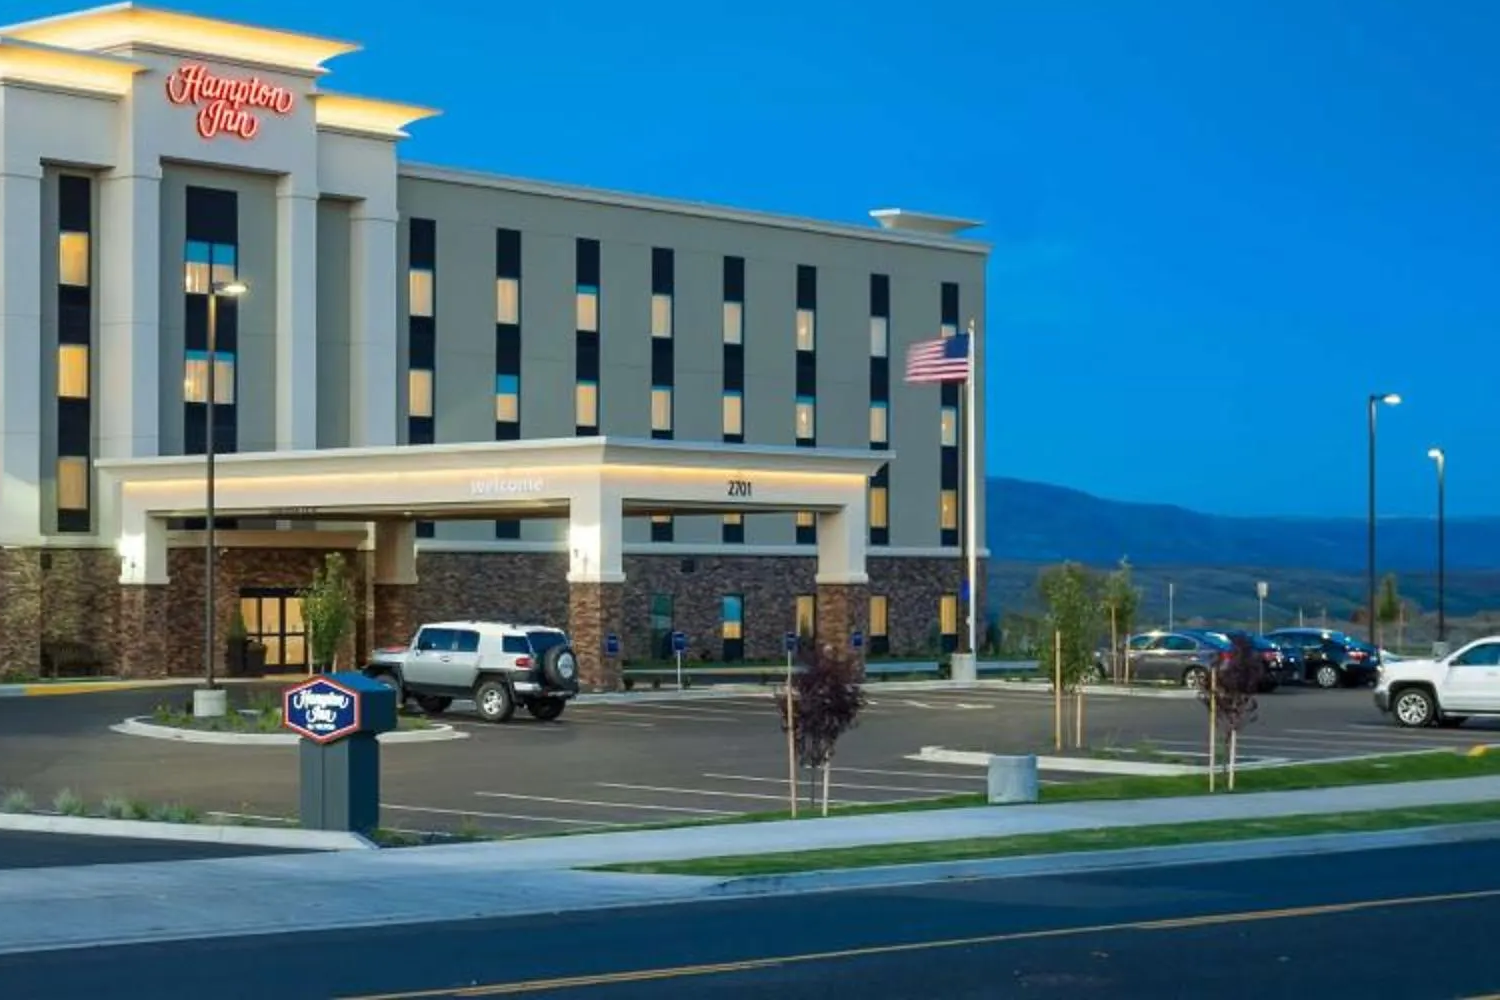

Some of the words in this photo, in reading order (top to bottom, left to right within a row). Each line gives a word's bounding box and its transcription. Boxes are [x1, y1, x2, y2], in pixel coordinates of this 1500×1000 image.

[167, 62, 293, 113] Hampton
[198, 99, 258, 138] Inn
[727, 479, 752, 497] 2701
[293, 689, 349, 710] Hampton
[306, 705, 337, 723] Inn
